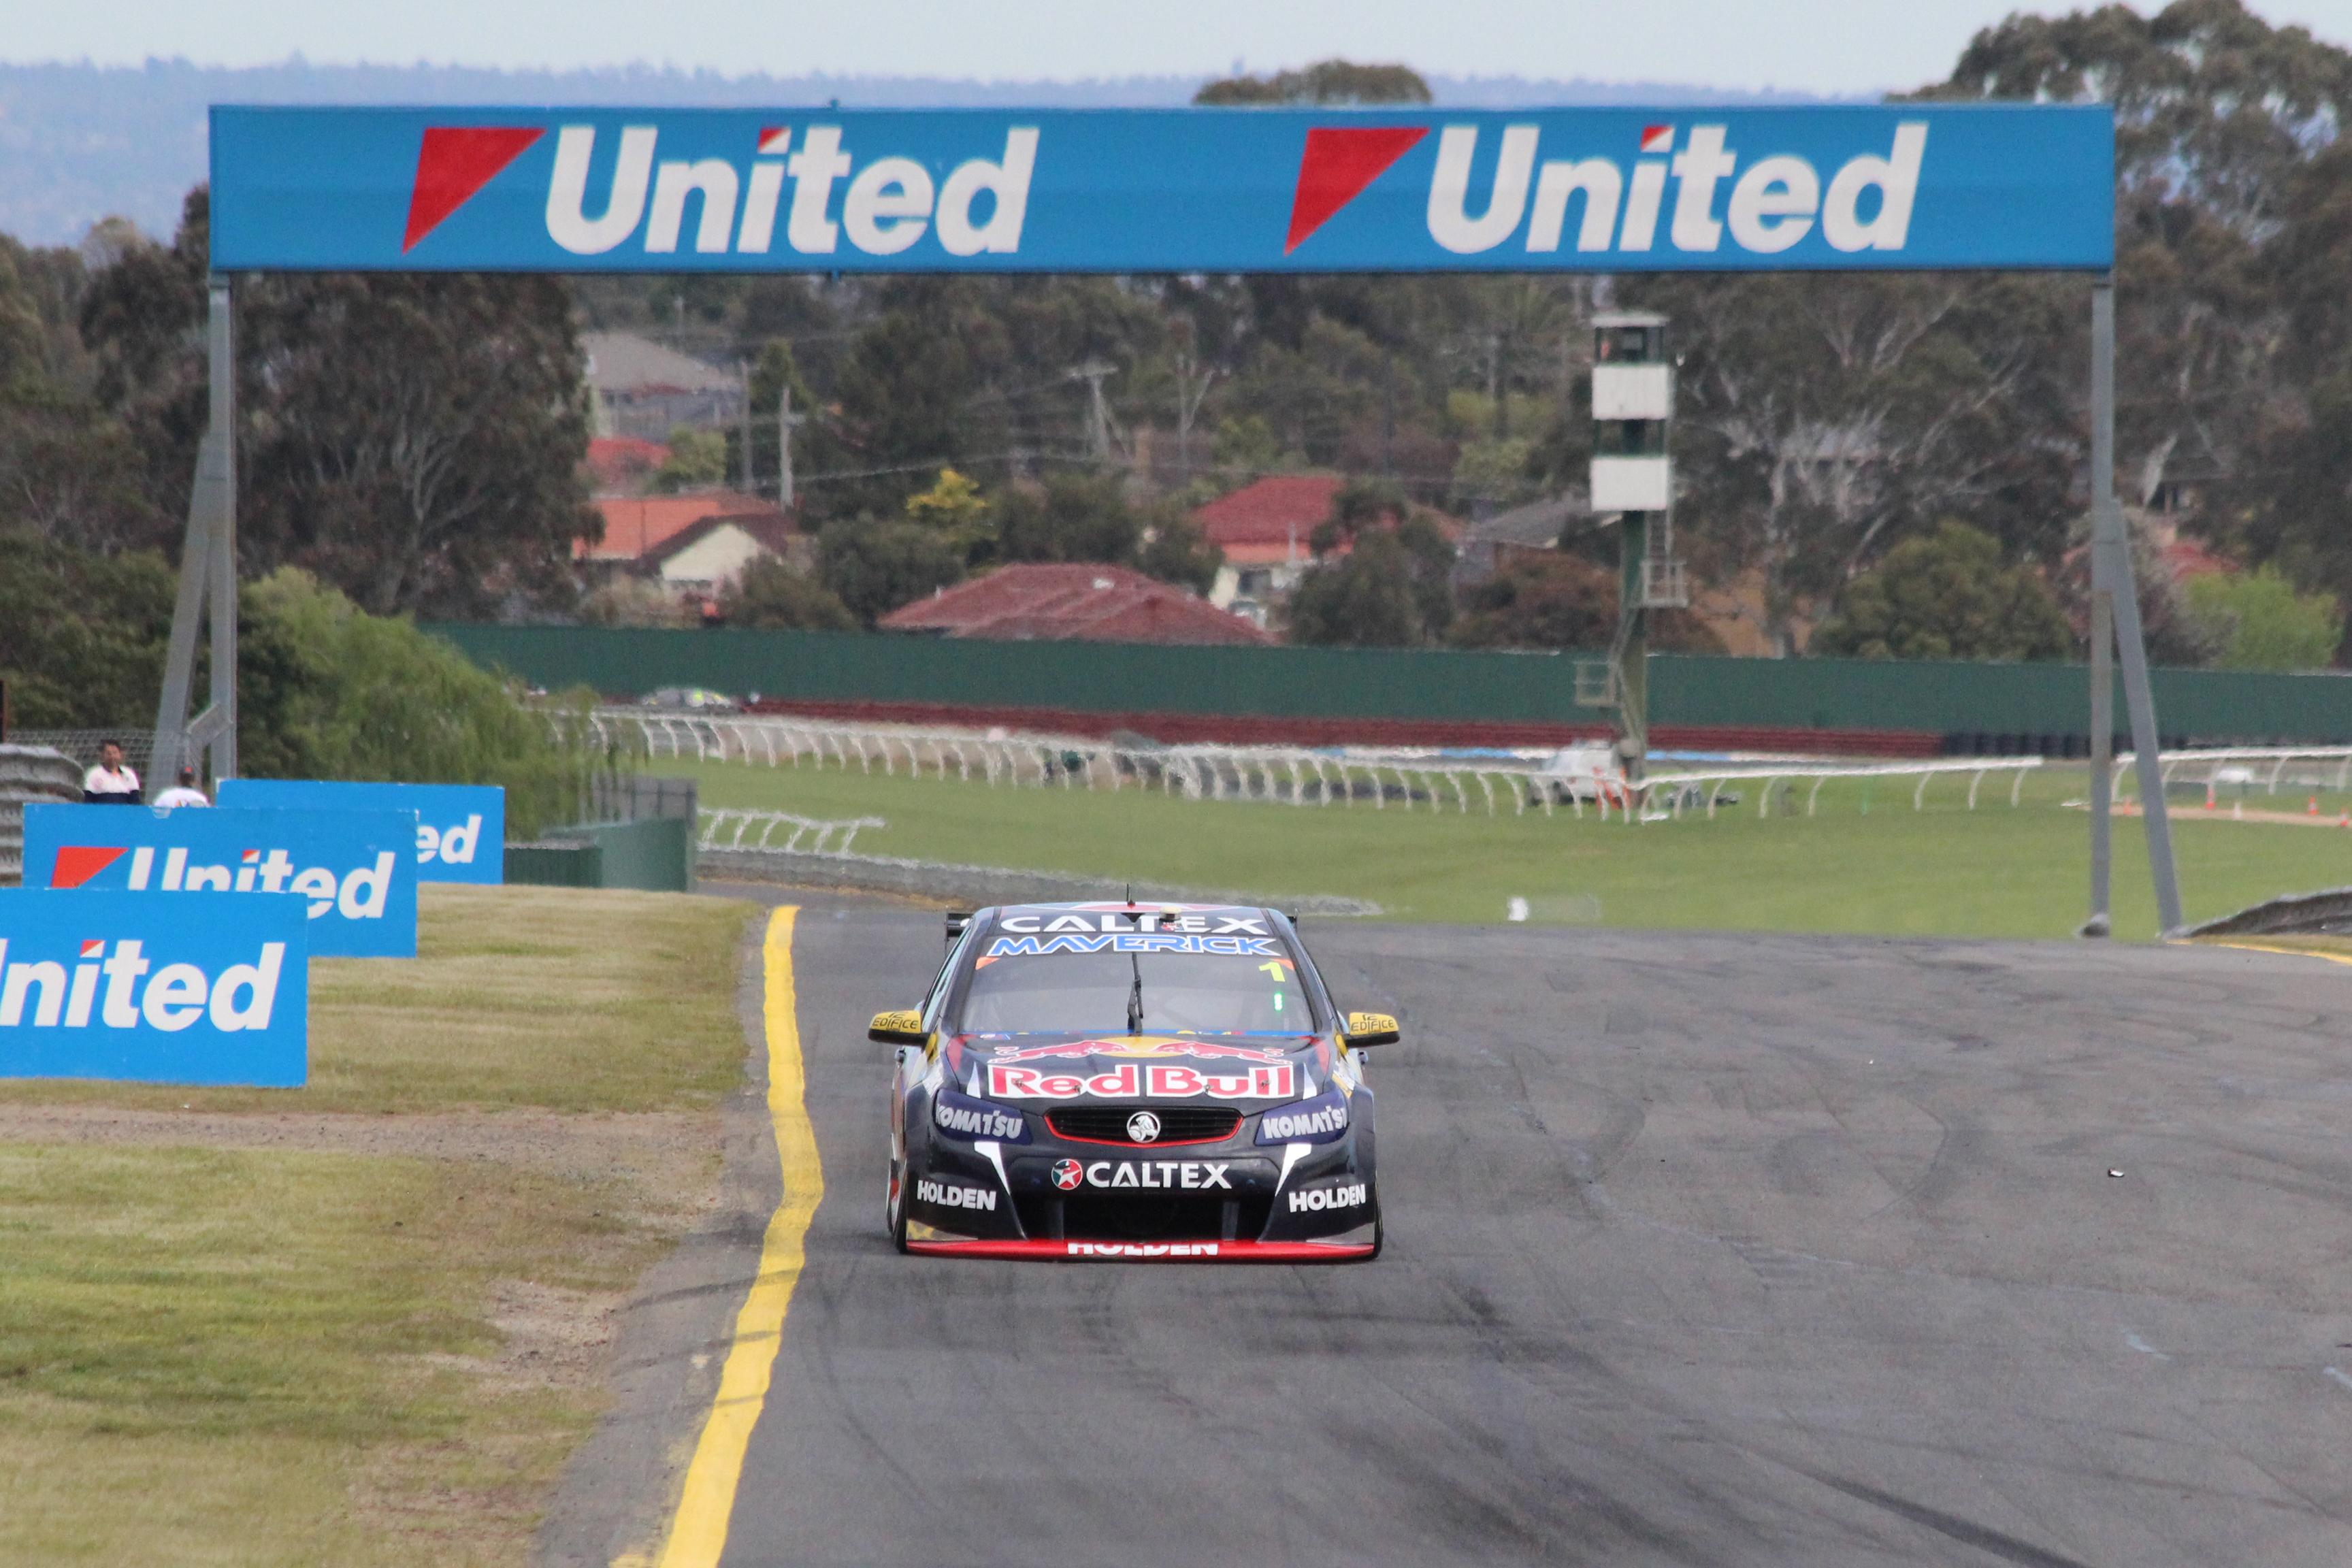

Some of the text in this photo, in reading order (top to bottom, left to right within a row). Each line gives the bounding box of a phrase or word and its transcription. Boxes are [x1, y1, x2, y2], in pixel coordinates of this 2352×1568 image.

[545, 125, 1039, 255] United
[1427, 122, 1929, 253] United
[1000, 915, 1269, 936] CALTEX
[987, 934, 1281, 956] MAVERICK
[0, 938, 285, 1031] nited
[1258, 962, 1286, 982] 1
[872, 1017, 918, 1029] EDIFICE
[1351, 1019, 1394, 1031] EDIFICE
[987, 1064, 1295, 1099] Red Bull
[936, 1104, 1023, 1139] KOMATSU
[1086, 1162, 1232, 1190] CALTEX
[917, 1179, 997, 1211] HOLDEN
[1288, 1183, 1367, 1213] HOLDEN
